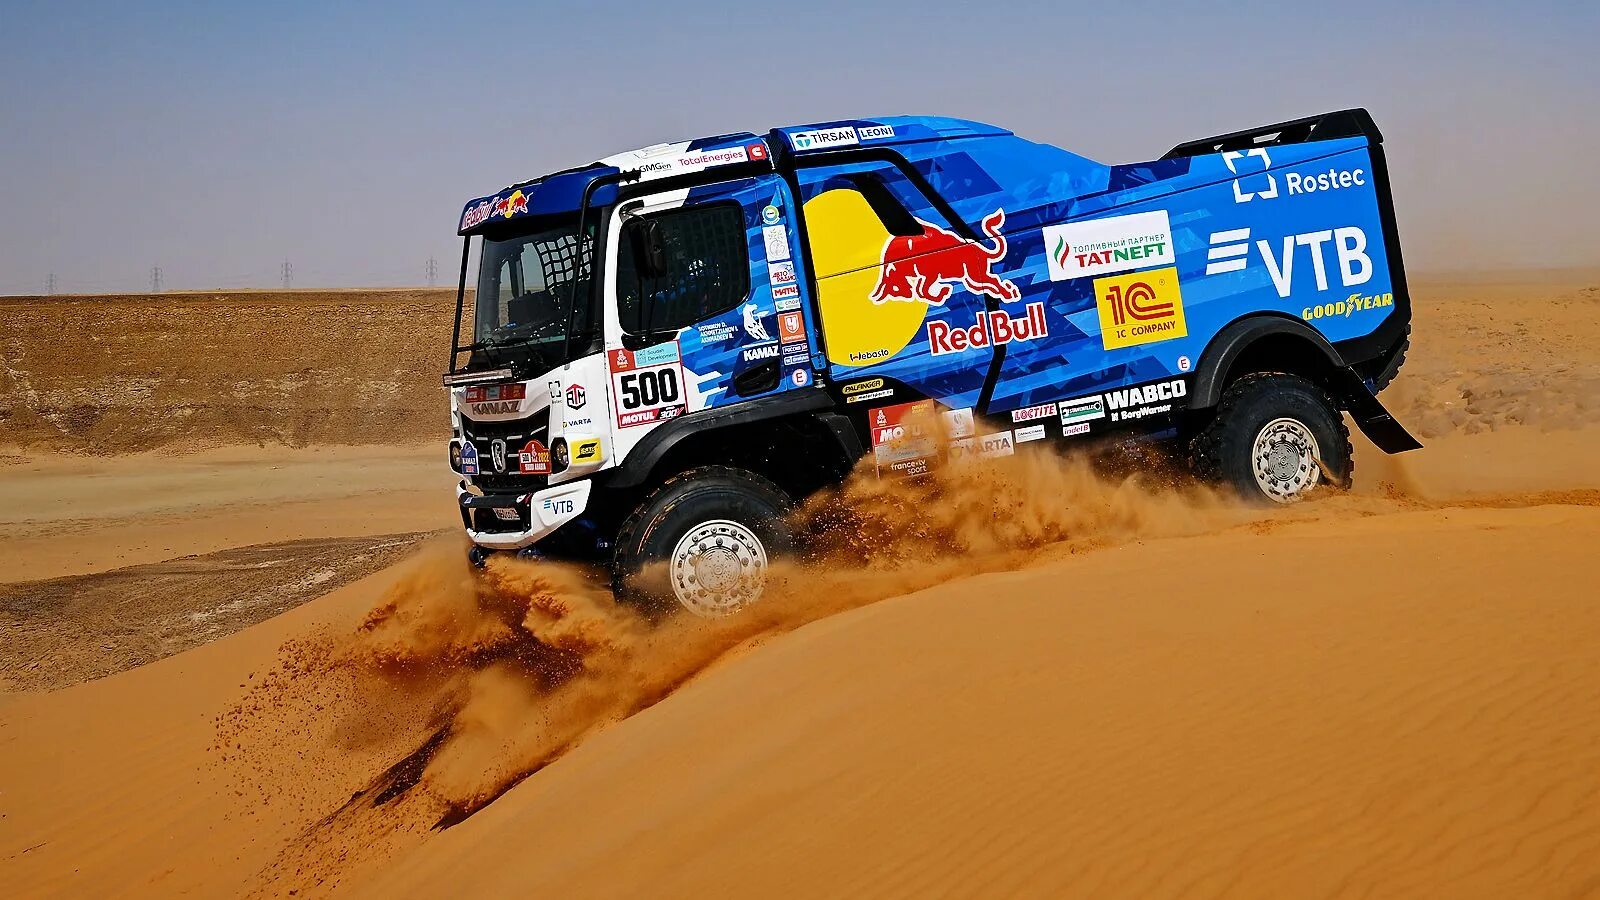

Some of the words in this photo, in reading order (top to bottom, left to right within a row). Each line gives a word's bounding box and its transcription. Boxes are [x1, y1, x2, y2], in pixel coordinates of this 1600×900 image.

[860, 127, 893, 138] LEONI
[678, 151, 744, 166] TotalEnergies
[1285, 168, 1366, 196] Rostec
[1073, 238, 1126, 253] ТОПЛИВНЫЙ
[1128, 234, 1165, 245] ПАРТНЕР
[1075, 242, 1166, 268] TATNEFT
[1256, 226, 1373, 298] VTB
[928, 311, 989, 356] Red
[988, 302, 1048, 346] Bull
[1131, 321, 1176, 337] COMPANY
[648, 352, 677, 361] Development
[744, 345, 780, 361] KAMAZ
[850, 349, 889, 362] Webasto
[620, 368, 679, 410] 500
[844, 379, 882, 392] PALFINGER
[1105, 380, 1187, 410] WABCO
[472, 401, 520, 415] KAMAZ
[1014, 406, 1055, 421] LOCTITE
[1121, 403, 1171, 420] BorgWarner
[569, 418, 591, 427] VARTA
[622, 411, 655, 425] MOTUL
[907, 465, 927, 476] sport
[552, 500, 574, 515] VTB
